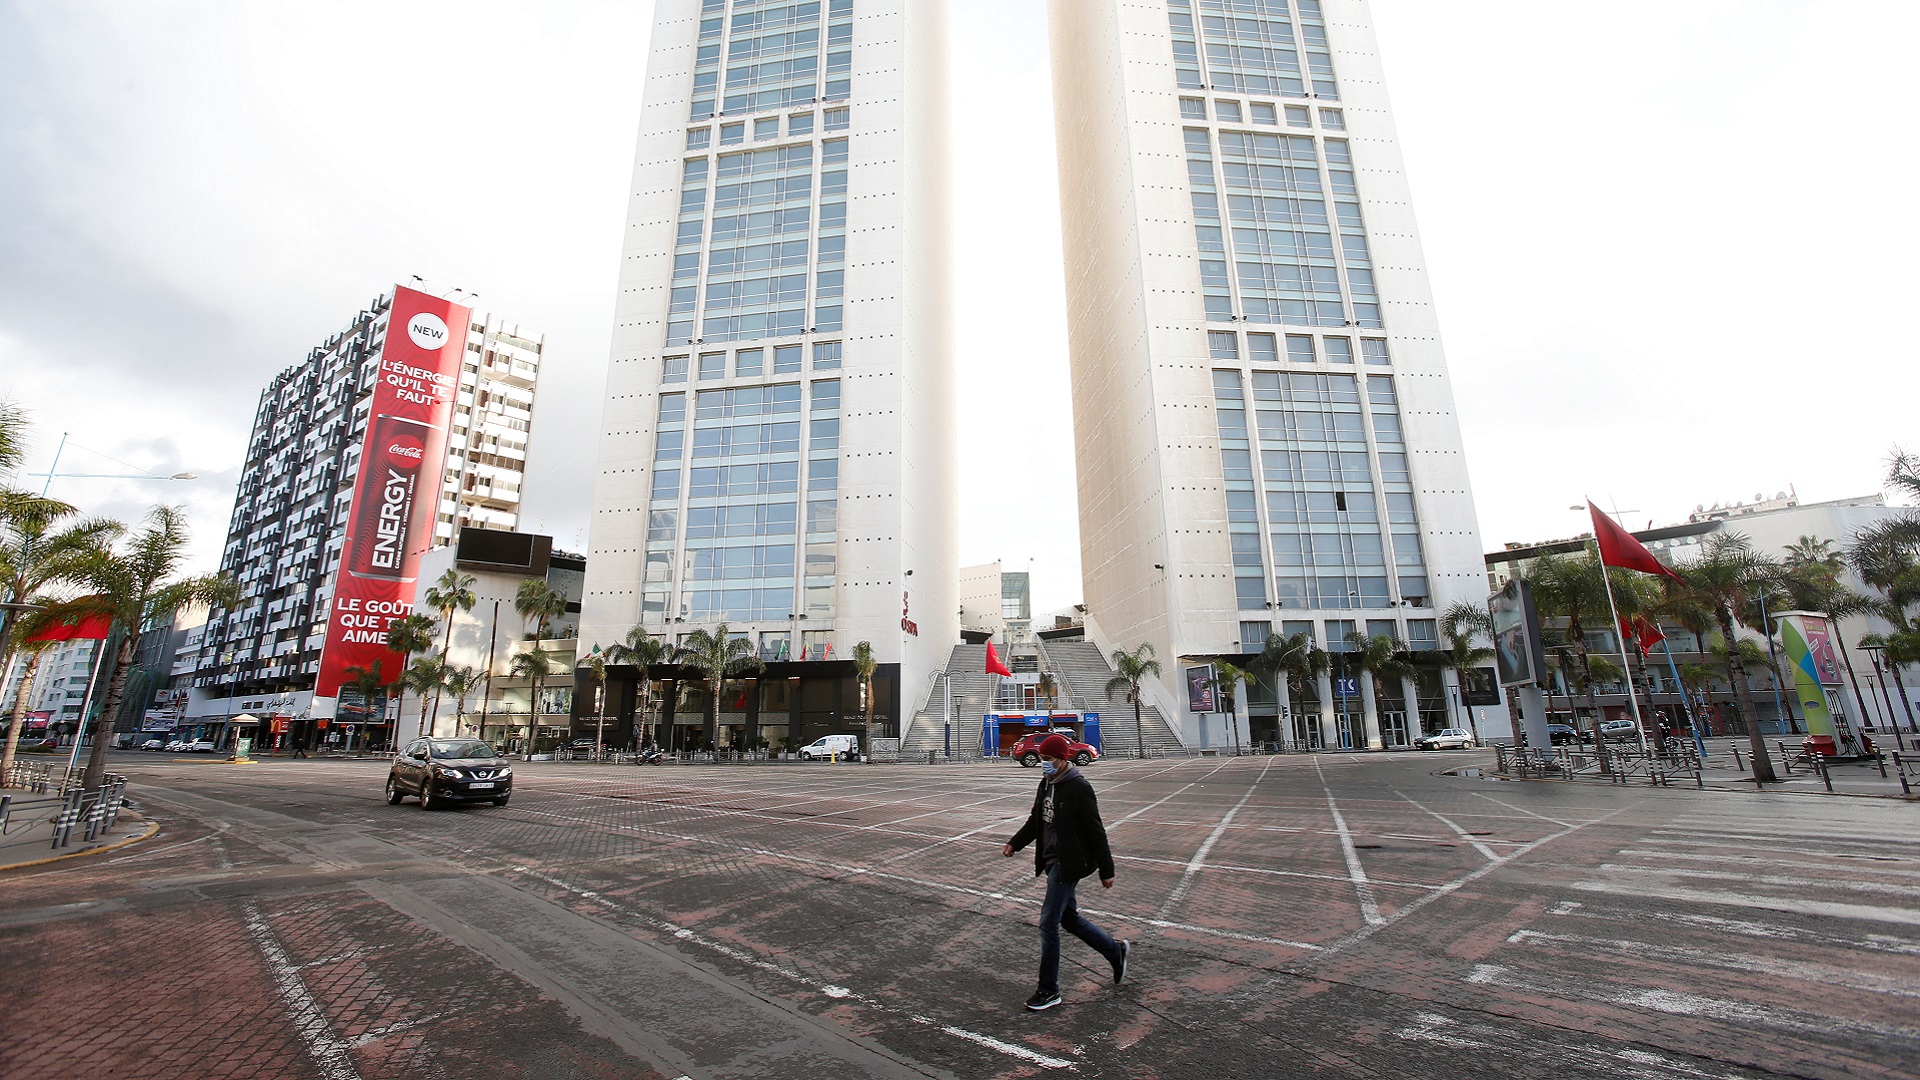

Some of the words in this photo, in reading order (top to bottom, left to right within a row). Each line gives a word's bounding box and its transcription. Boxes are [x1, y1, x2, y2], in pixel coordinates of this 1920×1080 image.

[413, 324, 443, 339] NEW
[382, 359, 456, 388] L'ÉNERGIE
[386, 374, 426, 392] QU'IL
[430, 383, 449, 398] TE
[396, 388, 435, 406] FAUT
[371, 468, 408, 568] ENERGY
[337, 597, 361, 611] LE
[365, 599, 414, 616] GOÛT
[340, 613, 380, 628] QUE
[341, 629, 392, 645] AIME
